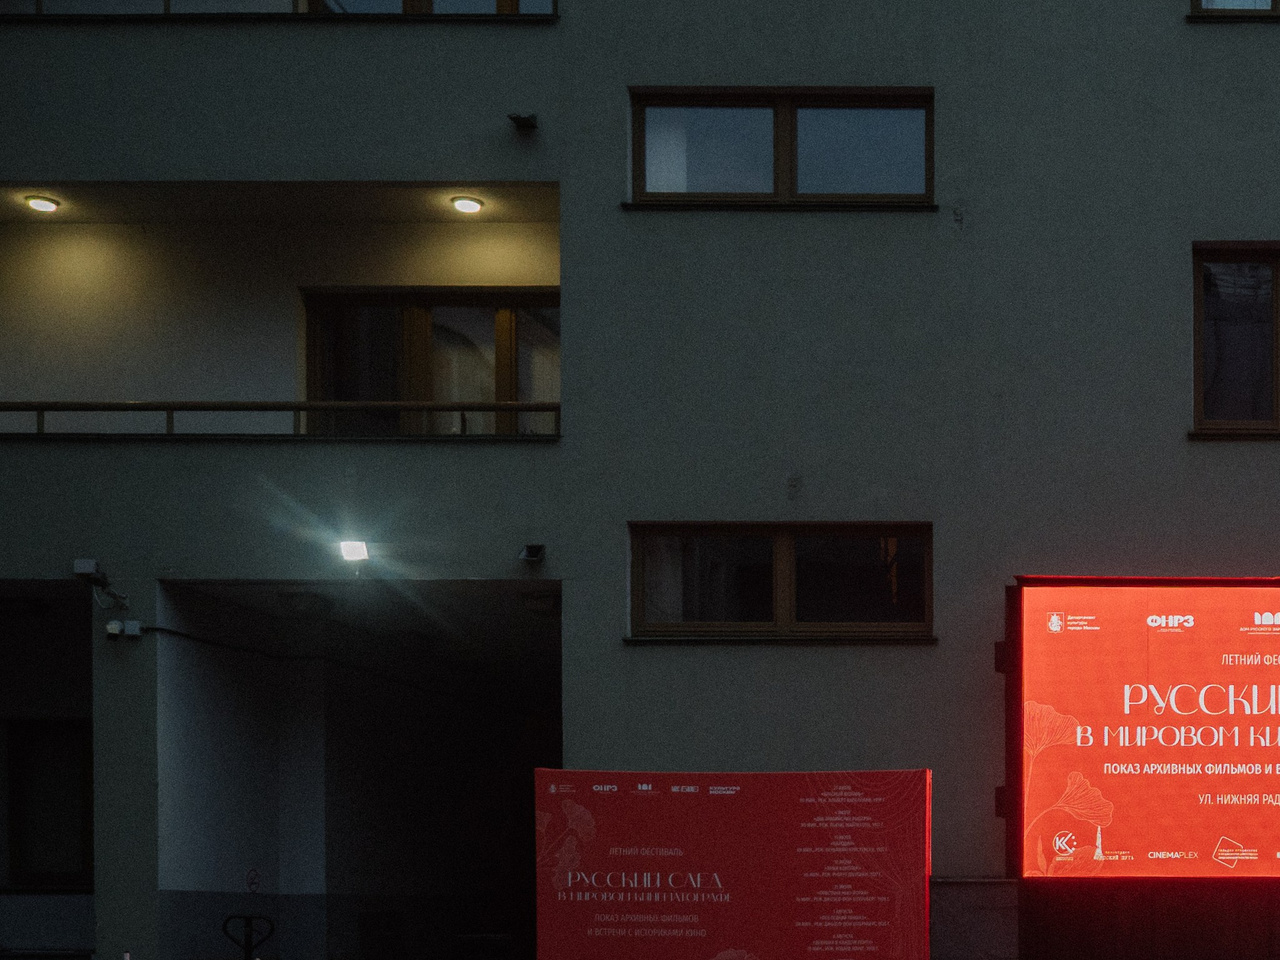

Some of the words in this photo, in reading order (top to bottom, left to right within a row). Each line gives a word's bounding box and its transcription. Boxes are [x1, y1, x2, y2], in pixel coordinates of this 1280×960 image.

[1147, 615, 1195, 627] ФНРЗ
[1221, 652, 1261, 665] ЛЕТНИЙ
[1076, 726, 1094, 747] В
[1104, 726, 1239, 747] МИРОВОМ
[1103, 763, 1141, 774] ПОКАЗ
[1143, 763, 1202, 774] АРХИВНЫХ
[1204, 763, 1262, 774] ФИЛЬМОВ
[1264, 763, 1273, 774] И
[1198, 794, 1214, 805] УЛ.
[1216, 794, 1259, 805] НИЖНЯЯ
[609, 847, 638, 857] ЛЕТНИЙ
[640, 847, 684, 857] ФЕСТИВАЛЬ
[1148, 851, 1198, 859] CINEMAPLEX
[595, 914, 619, 923] ПОКАЗ
[661, 914, 699, 923] ФИЛЬМОВ
[595, 929, 626, 938] ВСТРЕЧИ
